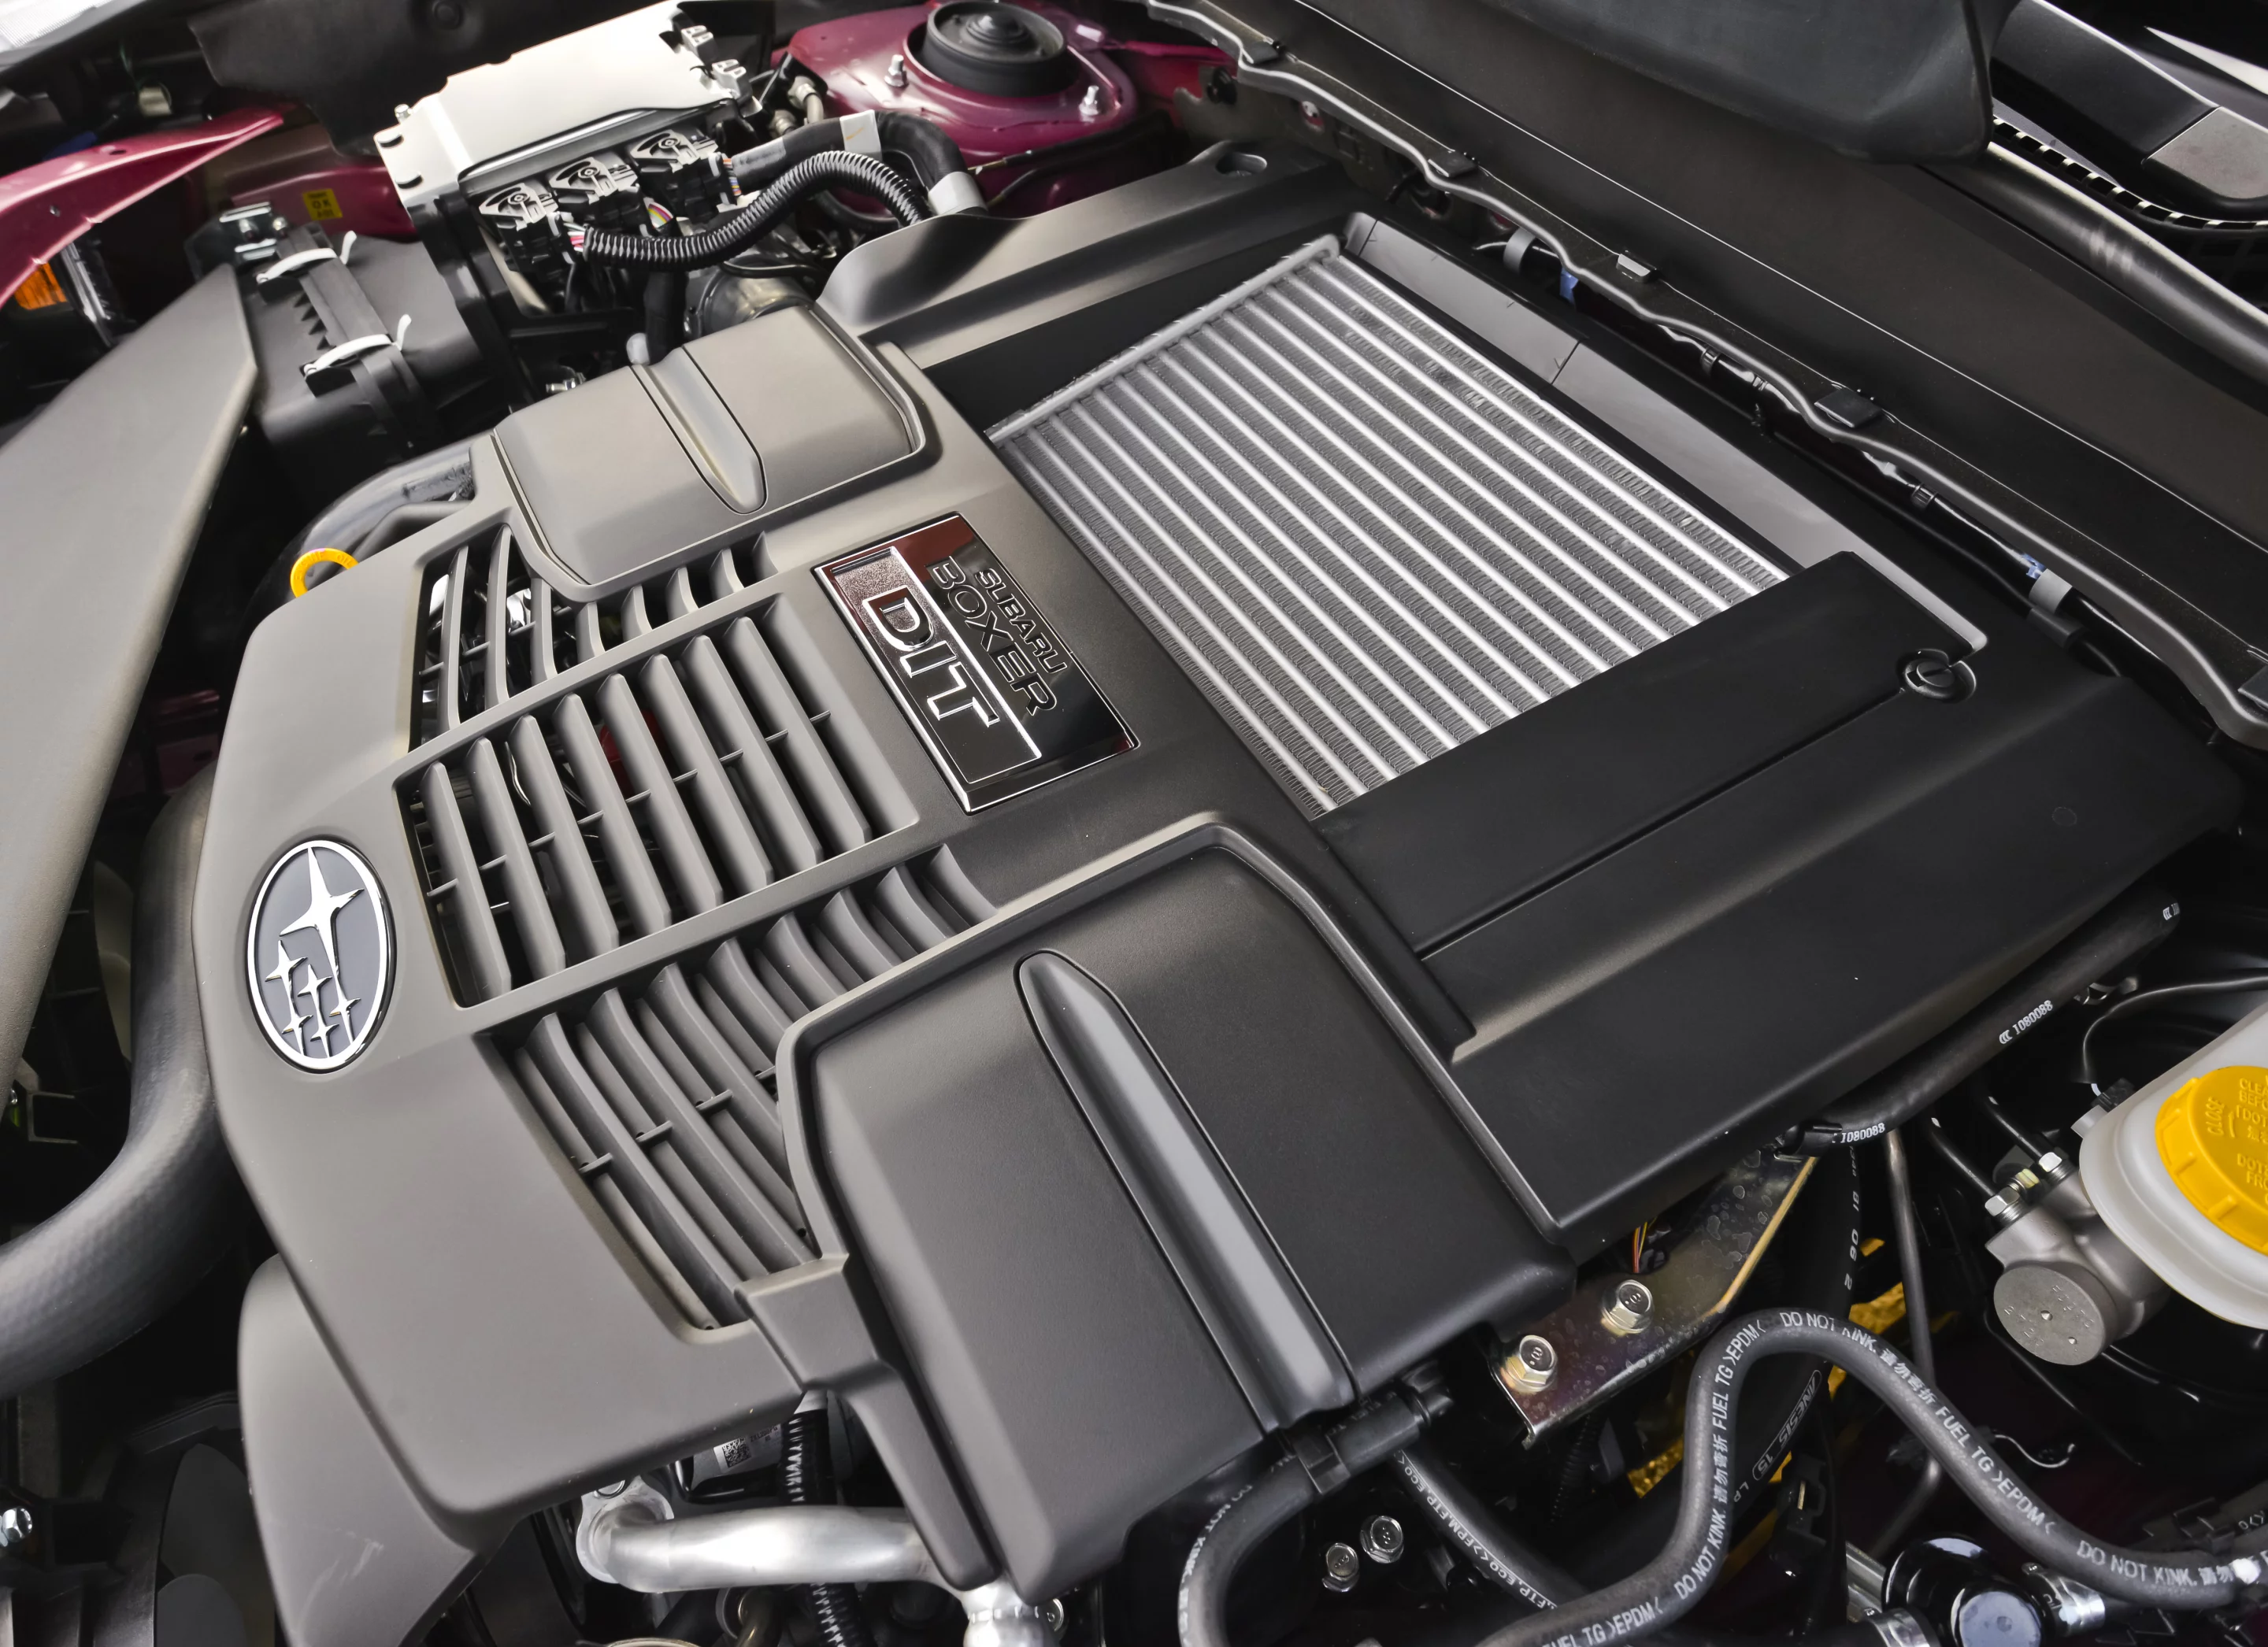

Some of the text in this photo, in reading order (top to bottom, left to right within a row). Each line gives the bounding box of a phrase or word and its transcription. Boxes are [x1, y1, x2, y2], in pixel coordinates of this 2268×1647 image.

[925, 555, 1057, 716] BOXER
[975, 568, 1068, 674] SUBARU
[862, 584, 1000, 727] DIT
[2206, 1096, 2225, 1136] CLOSE
[1714, 1364, 1733, 1387] TG
[1780, 1311, 1803, 1327] DO
[1807, 1313, 1835, 1331] NOT
[1935, 1405, 1977, 1449] FUEL
[1971, 1446, 1994, 1472] TG
[1712, 1391, 1729, 1430] FUEL
[1691, 1549, 1717, 1583] NOT
[2077, 1540, 2106, 1566] DO
[2110, 1554, 2148, 1579] NOT
[1674, 1574, 1697, 1600] DO
[1581, 1623, 1605, 1646] TG
